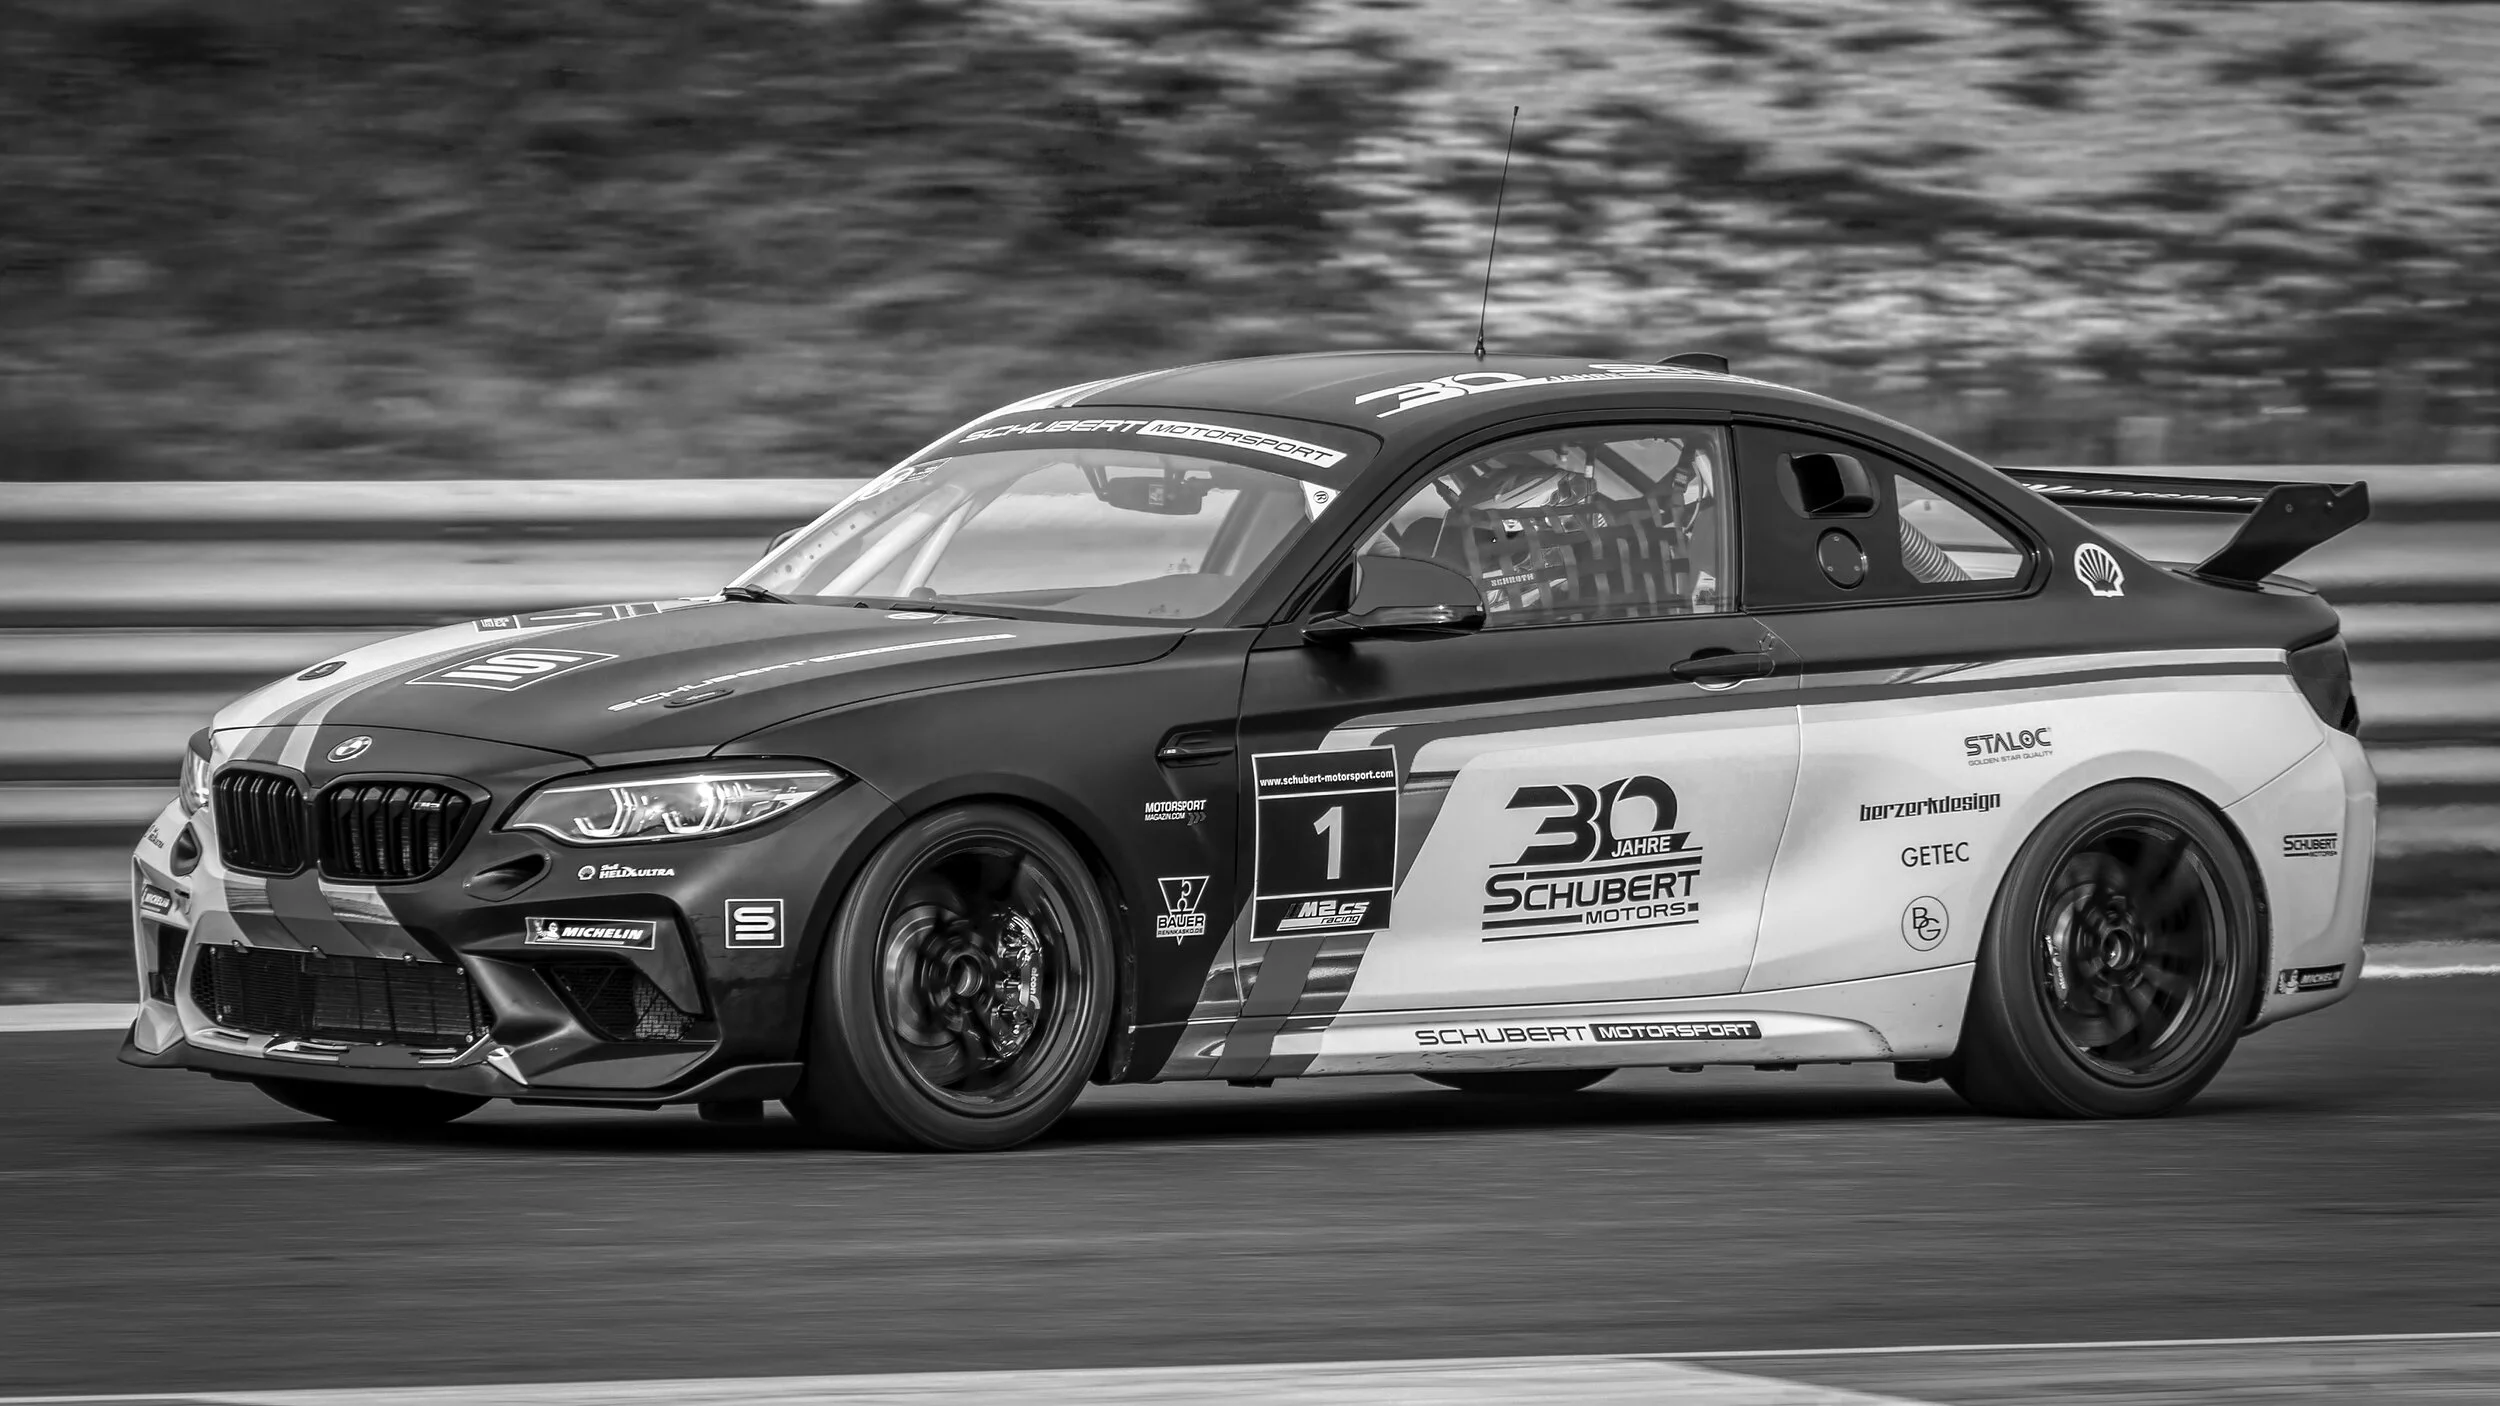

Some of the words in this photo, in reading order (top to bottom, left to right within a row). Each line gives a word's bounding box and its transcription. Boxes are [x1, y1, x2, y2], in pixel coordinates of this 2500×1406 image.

[1355, 372, 1527, 418] 30
[959, 419, 1149, 443] SCHUBERT
[1150, 423, 1334, 462] MOTORSPORT
[1964, 728, 2052, 756] STALOC
[1968, 757, 2000, 766] GOLDEN
[2001, 754, 2022, 763] STAR
[2023, 750, 2053, 760] QUALITY
[1260, 769, 1394, 787] www.schubert-motorsport.com
[1144, 812, 1186, 821] MAGAZIN.COM
[1145, 800, 1207, 813] MOTORSPORT
[1859, 792, 2001, 822] berzerkdesign
[1504, 774, 1678, 864] 30
[1313, 806, 1343, 880] 1
[1611, 835, 1671, 858] JAHRE
[2283, 834, 2338, 851] SCHUBERT
[1901, 841, 1970, 868] GETEC
[635, 868, 675, 878] ULTRA
[1483, 869, 1701, 914] SCHUBERT
[1158, 914, 1205, 929] BAUER
[1320, 914, 1361, 925] racing
[1585, 902, 1686, 925] MOTORS
[562, 926, 644, 941] MICHELIN
[1157, 927, 1204, 936] RENNKASKO.DE
[1414, 1025, 1588, 1046] SCHUBERT
[1598, 1023, 1755, 1040] MOTORSPORT
